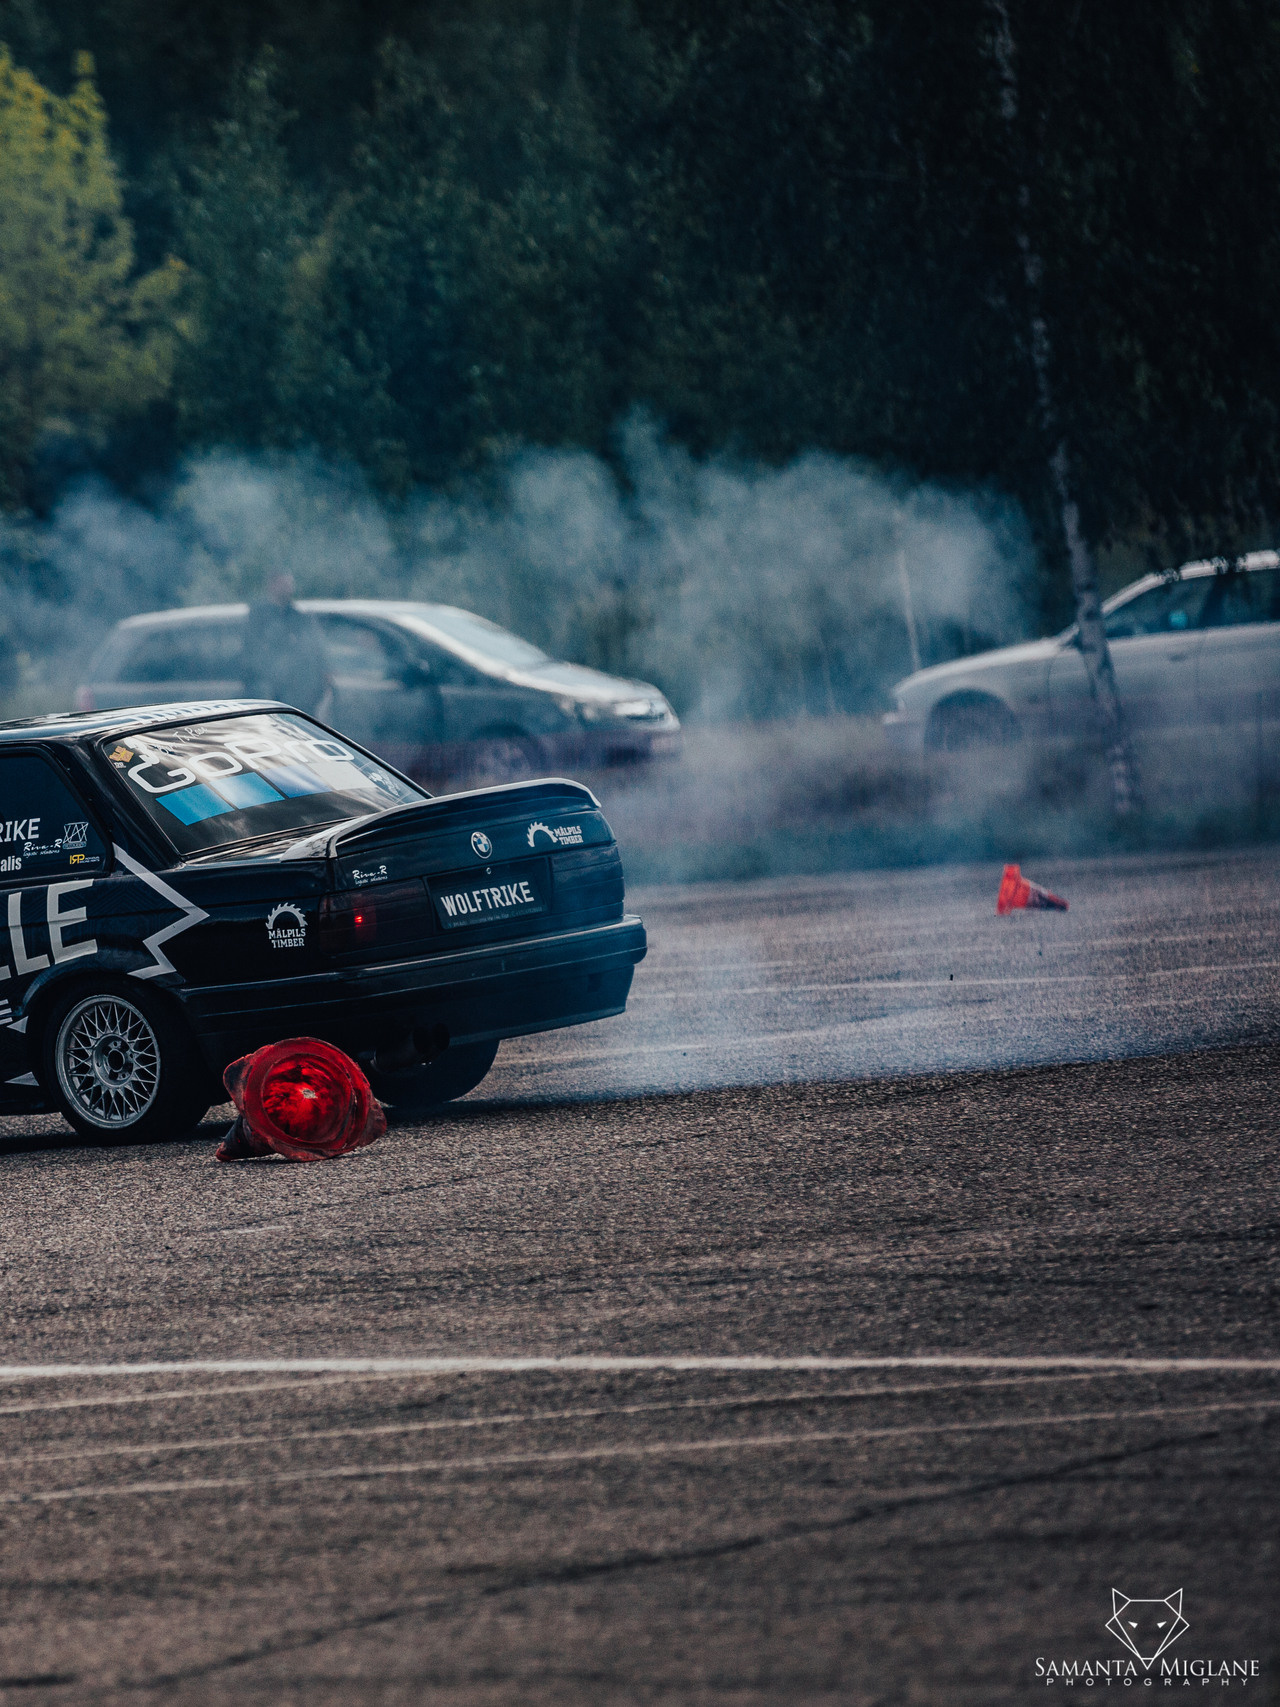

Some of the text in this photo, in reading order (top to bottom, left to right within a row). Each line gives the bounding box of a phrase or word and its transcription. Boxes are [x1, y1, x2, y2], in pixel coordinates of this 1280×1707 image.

[127, 738, 355, 794] GoPro
[559, 834, 584, 845] TIMBER
[440, 881, 535, 917] WOLFTRIKE
[271, 937, 305, 948] TIMBER
